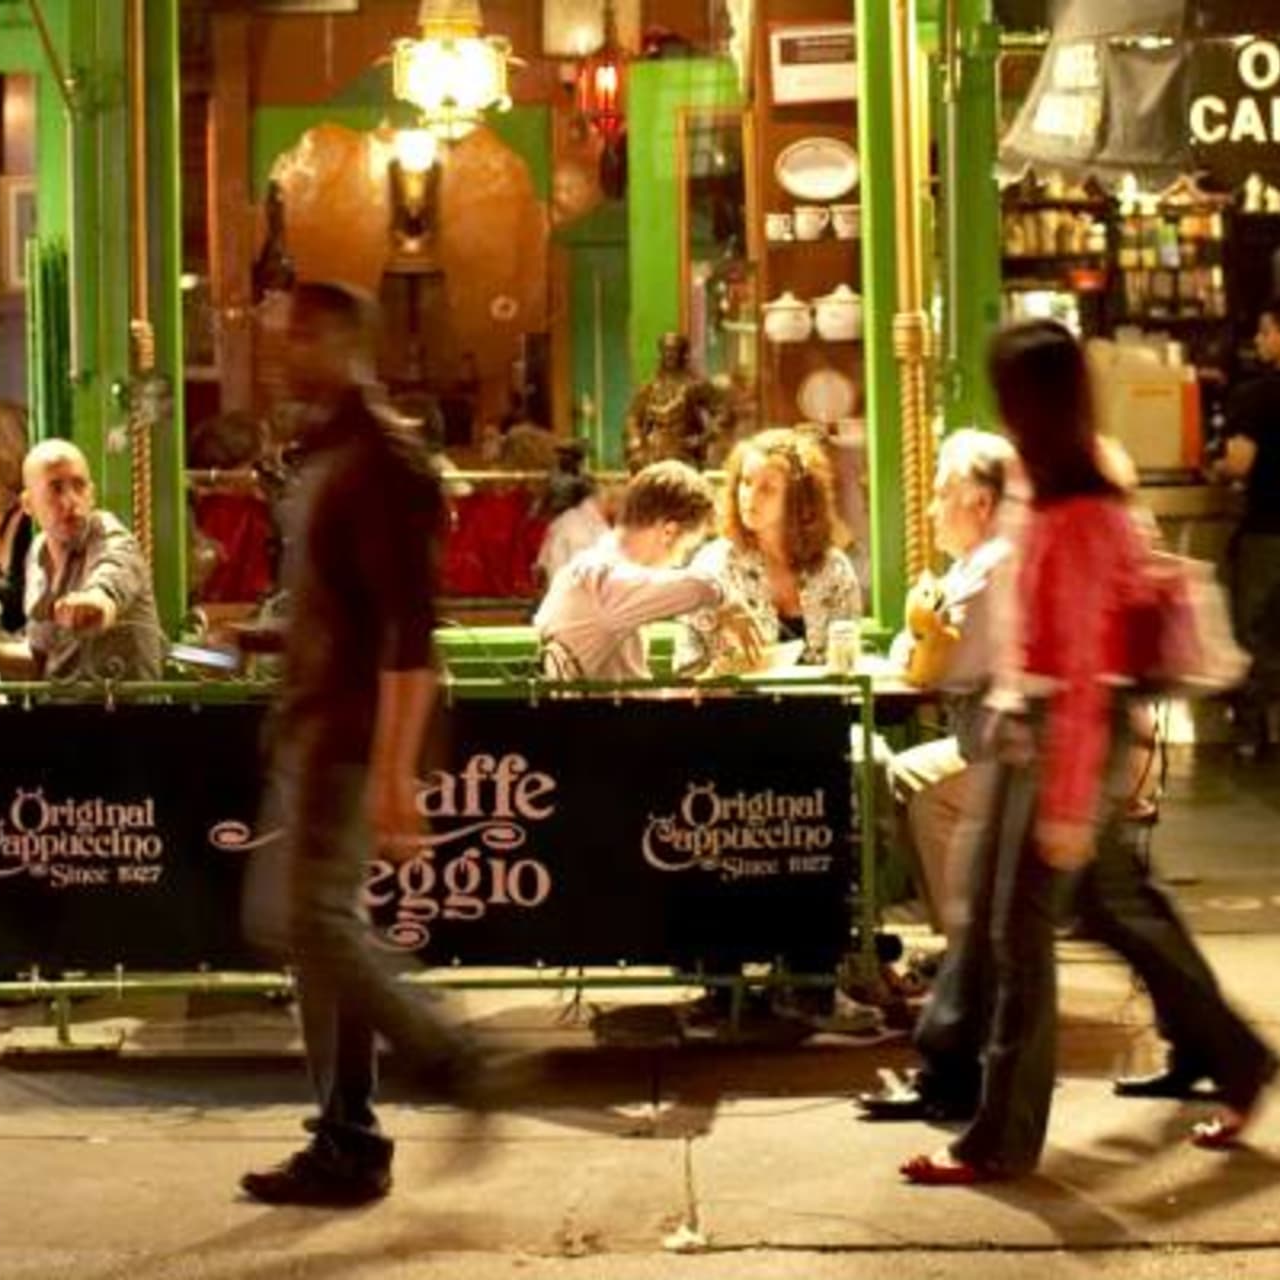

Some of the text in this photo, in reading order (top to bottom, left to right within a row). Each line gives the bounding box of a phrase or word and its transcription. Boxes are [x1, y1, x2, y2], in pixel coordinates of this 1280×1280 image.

[10, 786, 155, 833] Original
[410, 753, 557, 822] affe
[682, 783, 826, 828] Original
[642, 812, 833, 871] Cappuccino
[50, 863, 108, 888] Since
[358, 848, 552, 922] eggio
